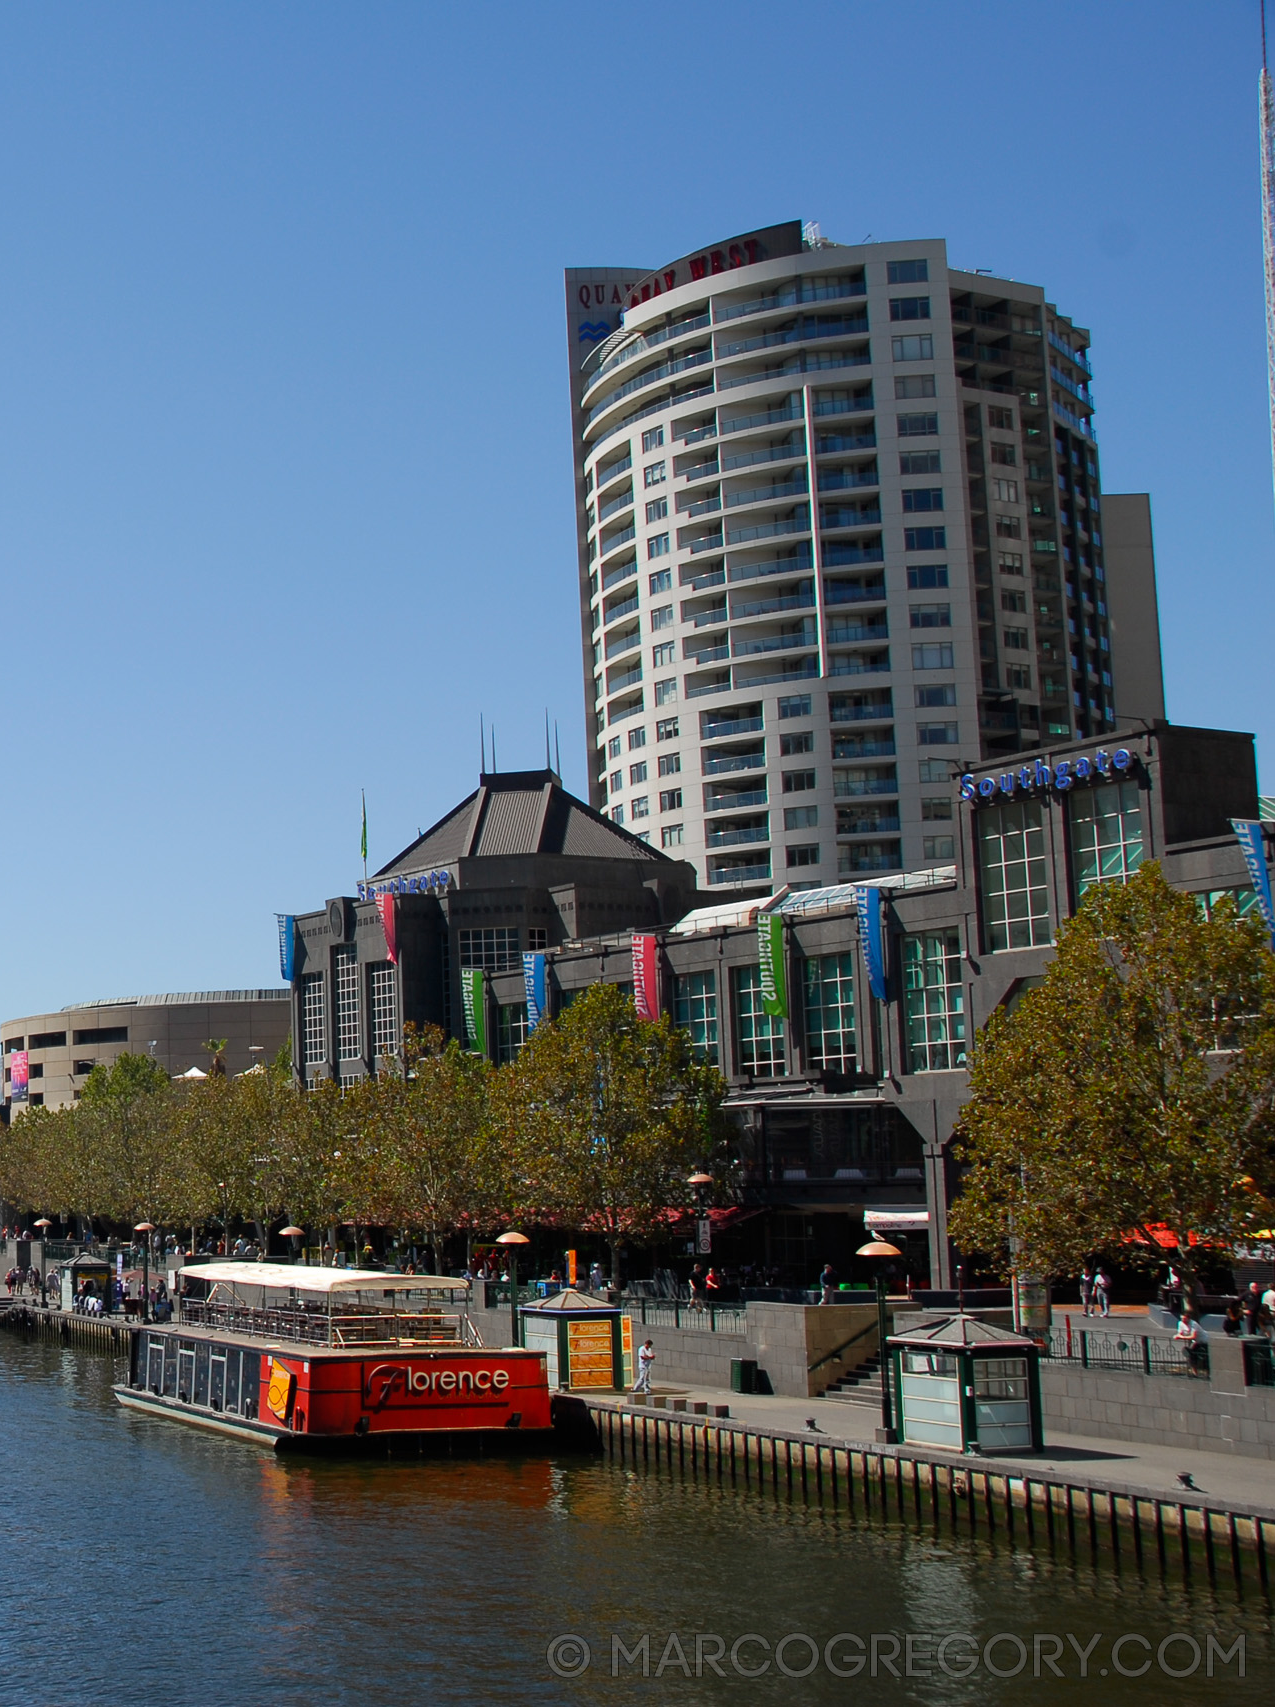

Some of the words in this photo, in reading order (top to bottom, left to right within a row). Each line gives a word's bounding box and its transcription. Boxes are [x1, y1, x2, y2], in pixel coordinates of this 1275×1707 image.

[688, 238, 759, 283] WEST
[961, 749, 1131, 800] Southgate
[357, 870, 450, 901] Southgate
[368, 1364, 509, 1408] Florence
